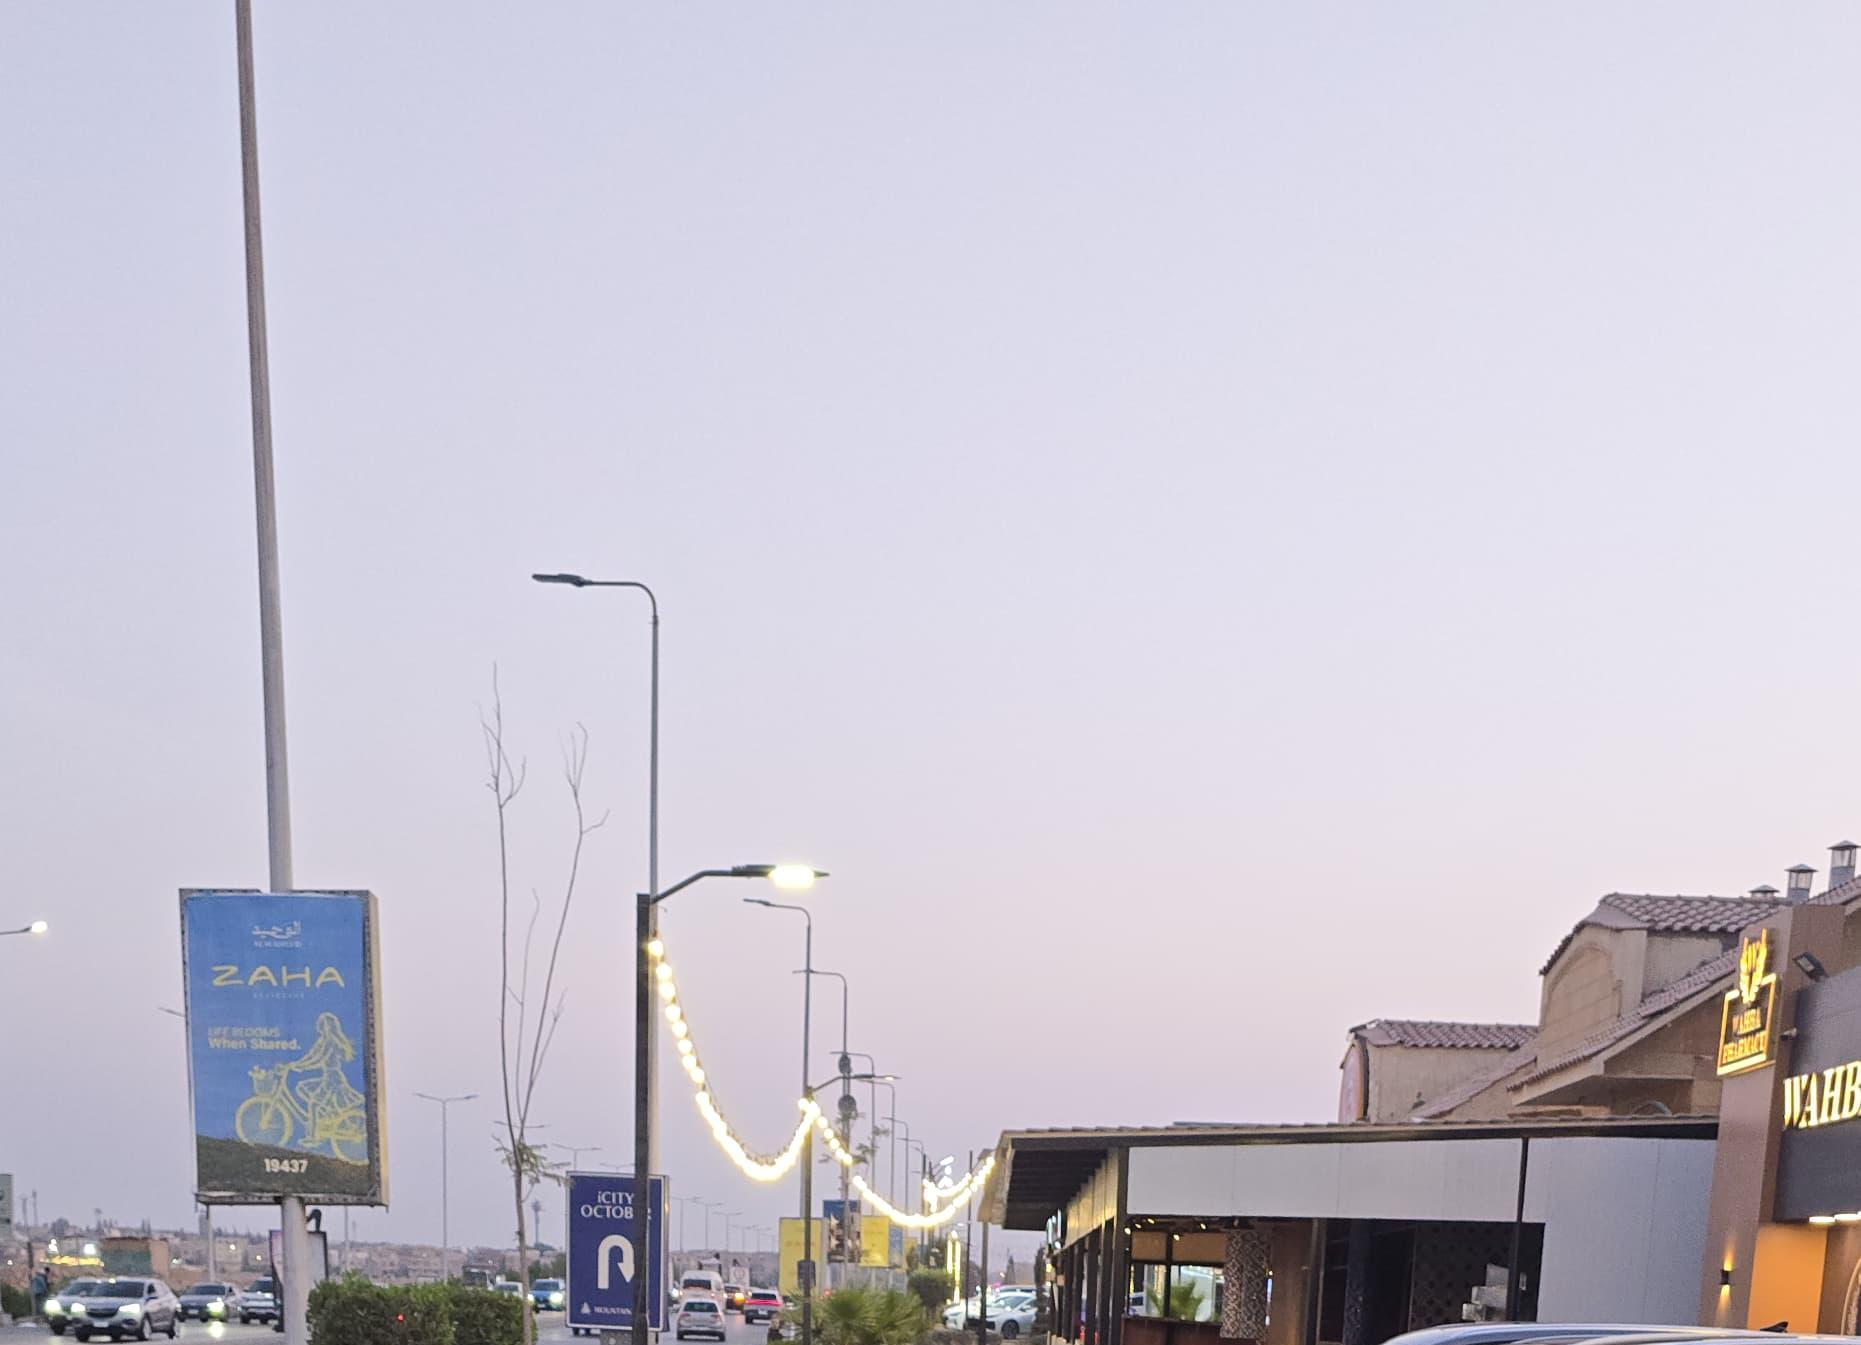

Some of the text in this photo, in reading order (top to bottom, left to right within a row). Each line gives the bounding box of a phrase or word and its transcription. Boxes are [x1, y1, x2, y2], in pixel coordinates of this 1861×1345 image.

[211, 965, 345, 988] ZAHA
[208, 1037, 302, 1050] When Shared.
[1783, 1060, 1861, 1129] WAHB
[264, 1158, 309, 1173] 19437
[597, 1191, 635, 1205] iCITY
[580, 1204, 652, 1220] OCTOB
